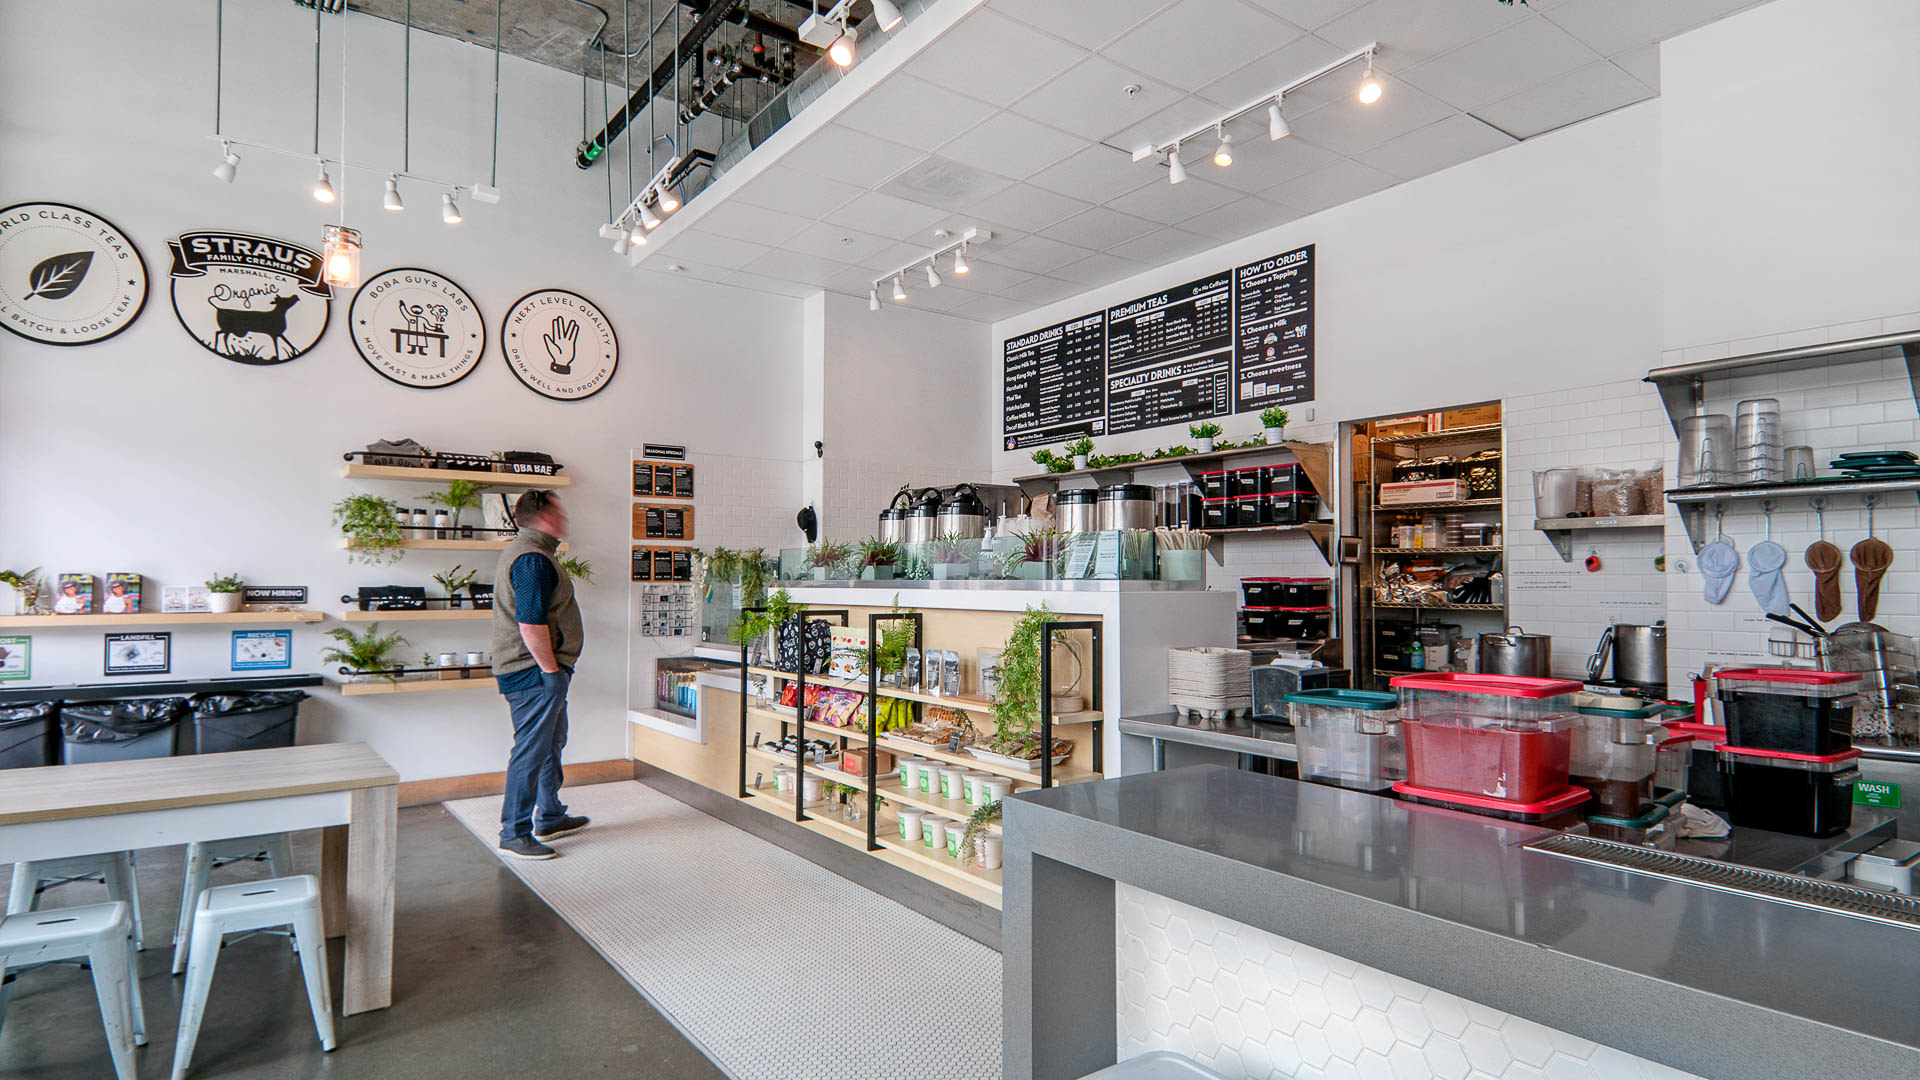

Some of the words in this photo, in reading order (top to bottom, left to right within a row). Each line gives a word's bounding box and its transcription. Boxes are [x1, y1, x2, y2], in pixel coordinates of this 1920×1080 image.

[0, 213, 31, 235] RLD
[39, 210, 92, 229] CLASS
[99, 229, 129, 260] TEAS
[191, 237, 313, 270] STRAUS
[206, 254, 243, 263] FAMILY
[245, 256, 300, 274] CREAMERY
[1240, 263, 1261, 279] HOW
[1262, 260, 1275, 271] TO
[1276, 250, 1308, 267] ORDER
[1209, 279, 1229, 288] Caffeine
[1245, 278, 1268, 289] Choose
[1272, 269, 1298, 281] Topping
[213, 283, 279, 308] Organic
[369, 278, 400, 299] BOBA
[405, 275, 438, 288] GUYS
[442, 287, 468, 312] LABS
[10, 313, 53, 333] BATCH
[73, 317, 112, 334] LOOSE
[113, 294, 132, 317] LEAF
[1110, 301, 1147, 320] PREMIUM
[1147, 294, 1168, 308] TEAS
[515, 302, 537, 324] NEXT
[540, 297, 574, 307] LEVEL
[580, 305, 611, 345] QUALITY
[1246, 325, 1268, 335] Choose
[1273, 319, 1287, 328] Milk
[1006, 334, 1039, 351] STANDARD
[1039, 326, 1064, 341] DRINKS
[363, 337, 383, 361] MOVE
[383, 361, 407, 376] FAST
[421, 372, 447, 381] MAKE
[450, 349, 473, 374] THINGS
[512, 348, 529, 374] DRINK
[530, 374, 552, 391] WELL
[577, 368, 607, 392] PROSPER
[1246, 370, 1268, 379] Choose
[1269, 363, 1302, 374] sweetness
[1110, 372, 1150, 390] SPECIALTY
[1150, 365, 1182, 381] DRINKS
[534, 463, 553, 475] BAE
[1857, 782, 1890, 794] WASH
